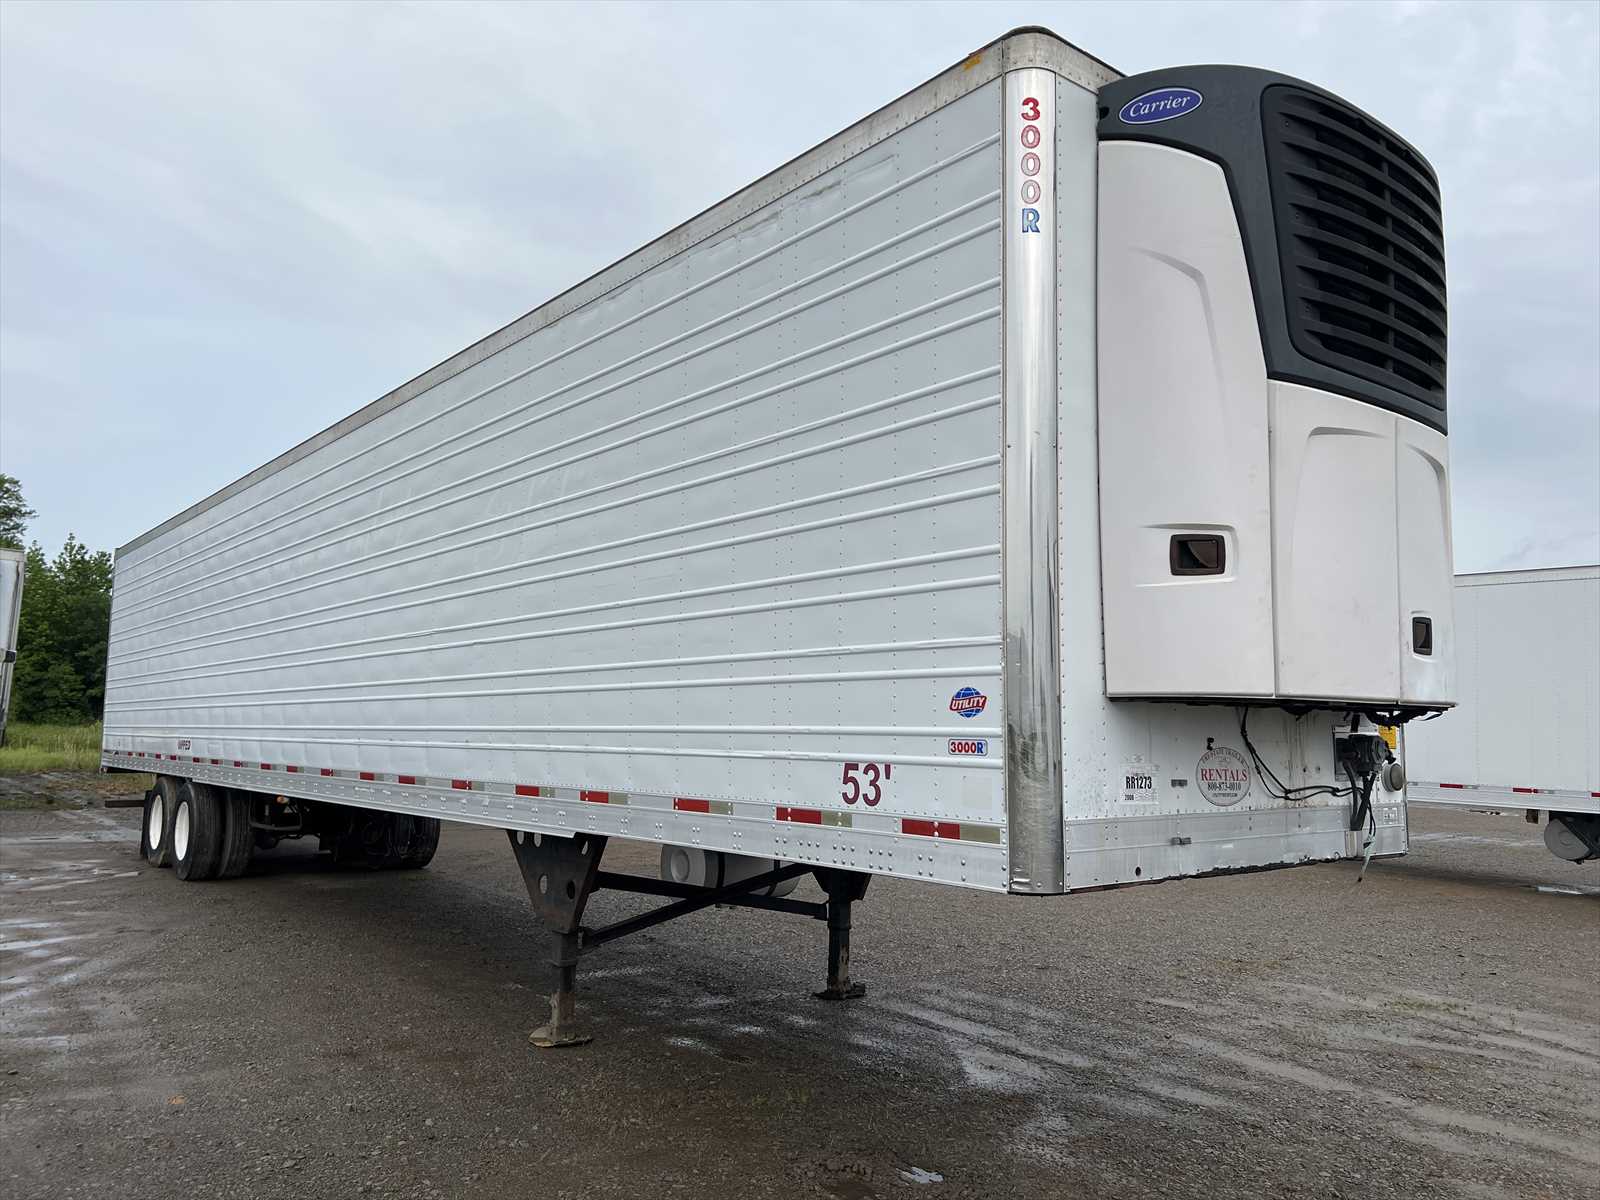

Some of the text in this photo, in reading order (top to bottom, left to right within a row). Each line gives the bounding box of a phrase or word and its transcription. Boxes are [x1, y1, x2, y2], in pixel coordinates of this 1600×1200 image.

[1130, 94, 1191, 117] Carrier
[1021, 97, 1041, 233] 3000R
[951, 697, 985, 710] UTILITY
[950, 741, 984, 754] 3000R
[1125, 775, 1152, 790] RR1273
[1201, 768, 1248, 782] RENTALS
[842, 763, 891, 807] 53'
